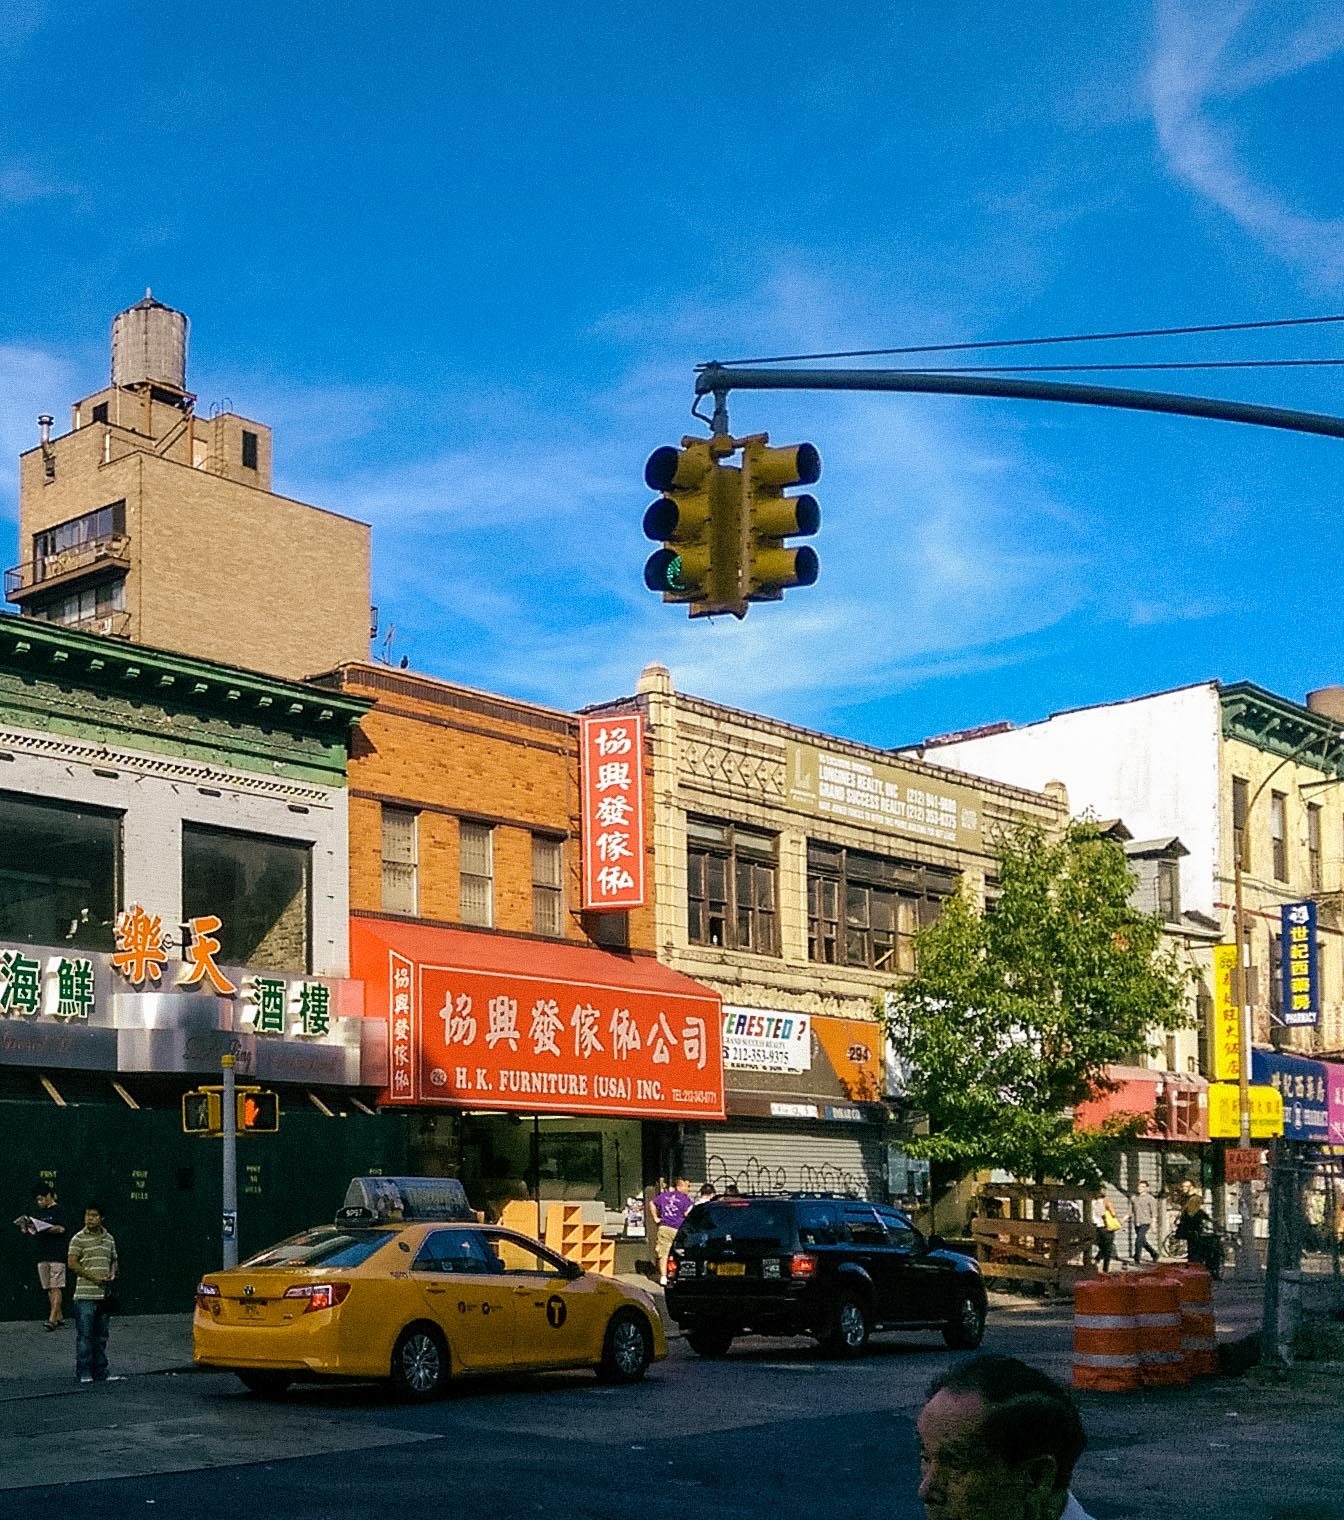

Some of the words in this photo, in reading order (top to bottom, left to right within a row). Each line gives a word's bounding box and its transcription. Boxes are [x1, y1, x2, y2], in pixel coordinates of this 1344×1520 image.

[733, 1047, 789, 1065] 212-353-9375
[849, 1047, 869, 1061] 294
[456, 1067, 472, 1089] H.
[476, 1068, 493, 1090] K.
[499, 1070, 588, 1096] FURNITURE
[594, 1074, 632, 1101] (USA)
[636, 1079, 665, 1100] INC.
